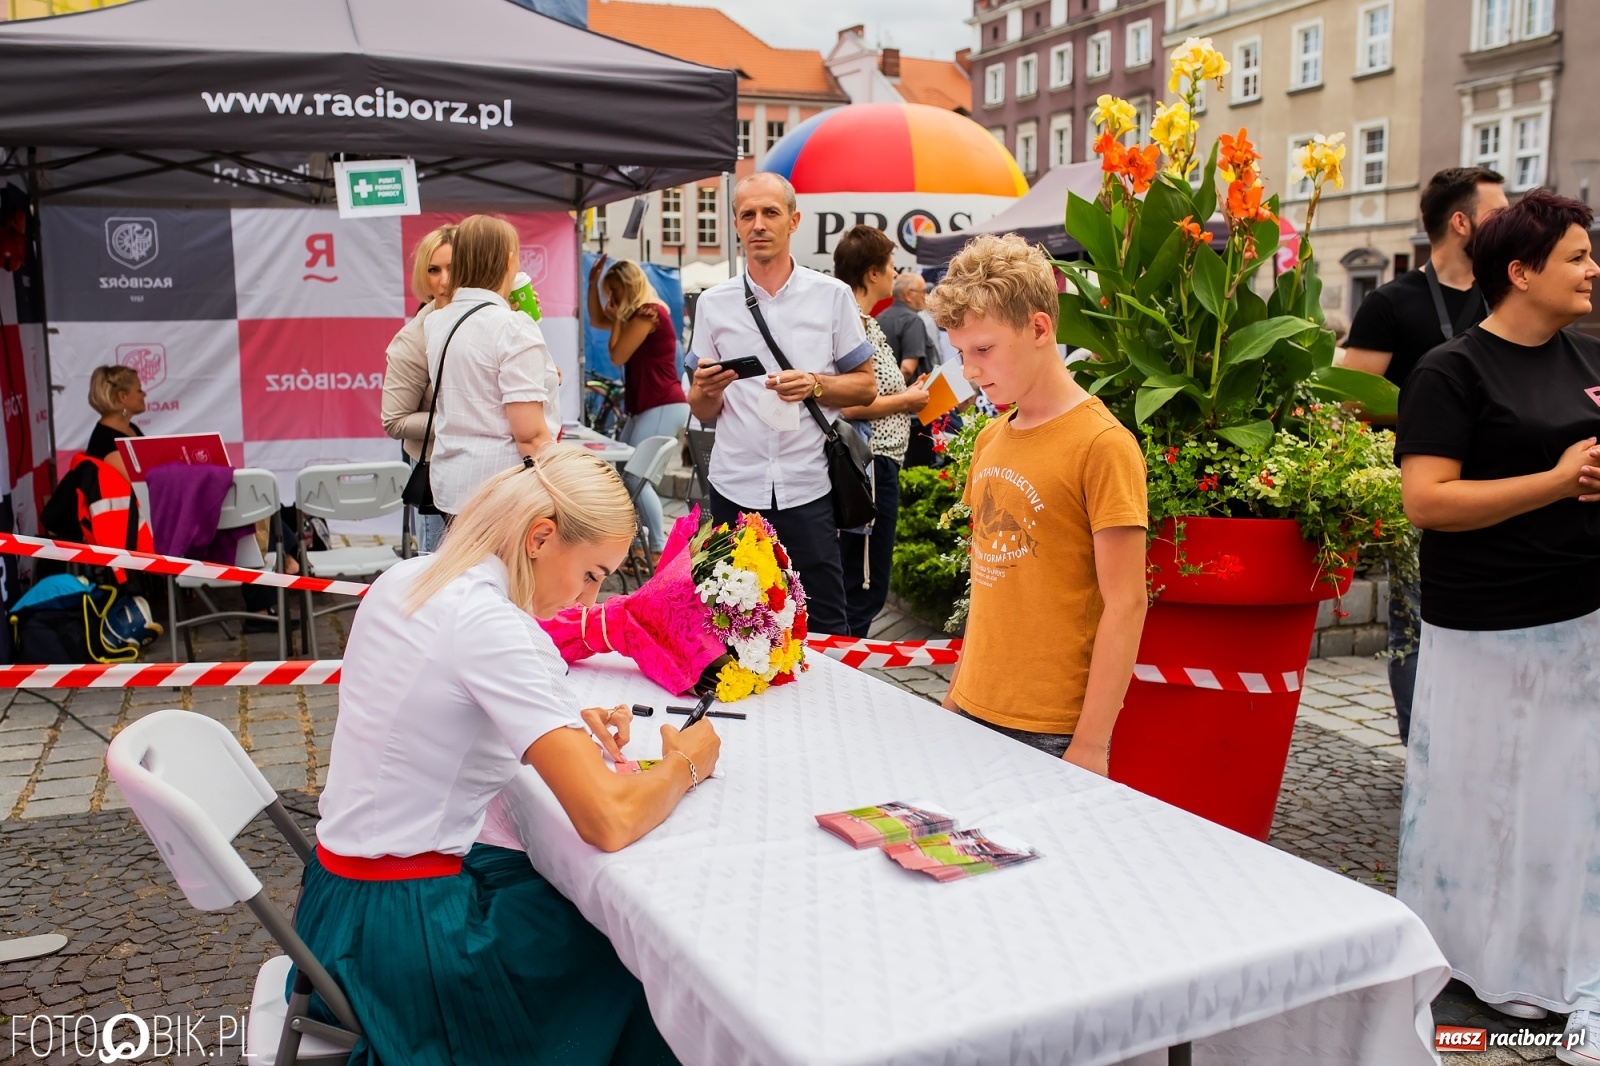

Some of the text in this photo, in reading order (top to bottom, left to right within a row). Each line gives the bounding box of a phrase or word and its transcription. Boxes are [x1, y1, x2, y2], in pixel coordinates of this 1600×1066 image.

[201, 87, 514, 130] www.raciborz.pl
[972, 466, 1045, 513] UNTAIN COLLECTIVE
